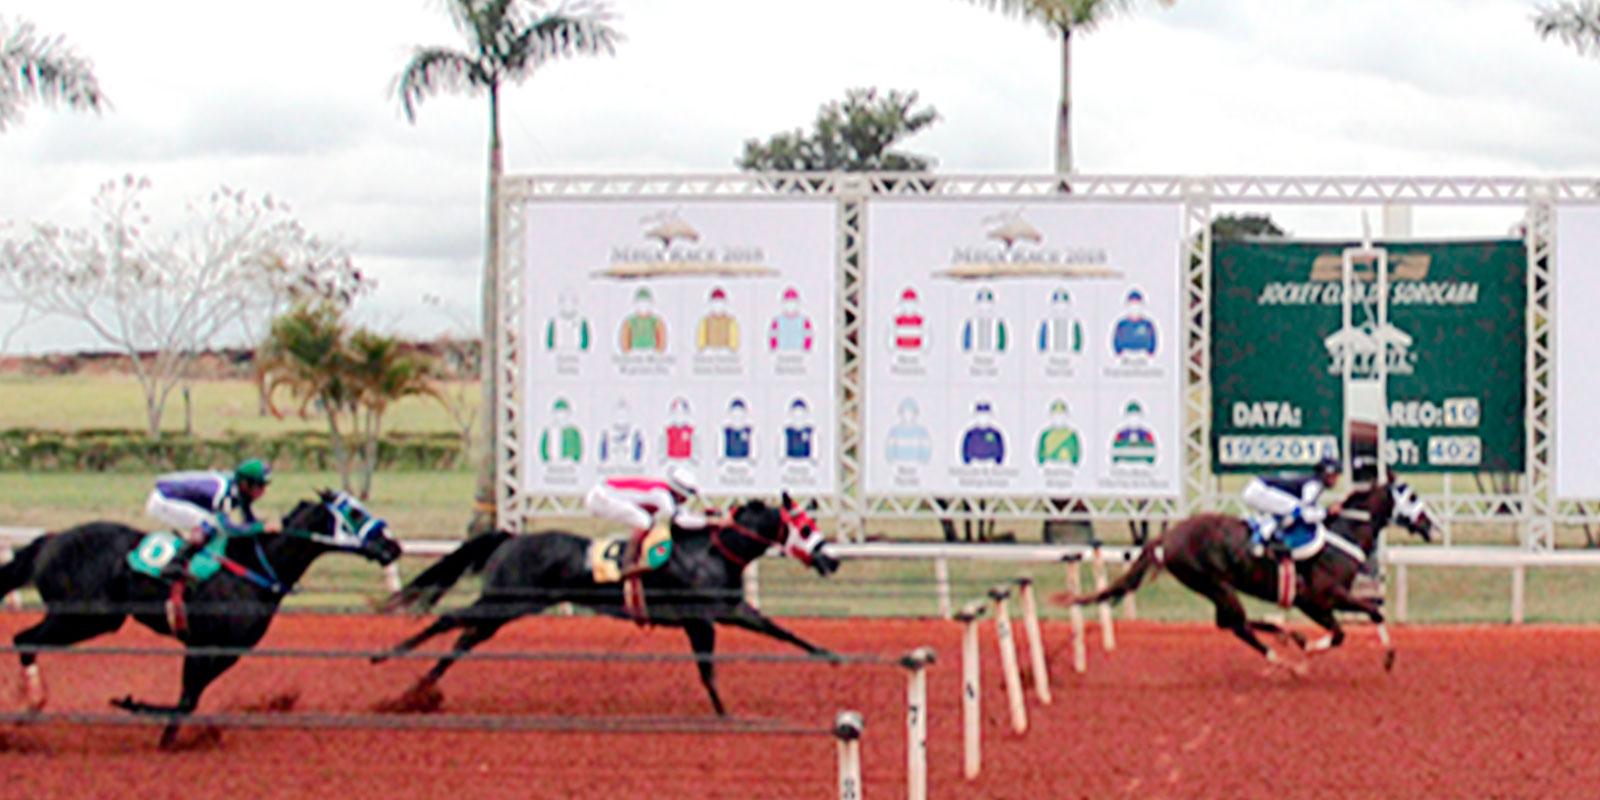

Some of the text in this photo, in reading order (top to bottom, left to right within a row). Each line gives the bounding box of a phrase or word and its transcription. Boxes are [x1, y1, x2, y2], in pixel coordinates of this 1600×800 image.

[1258, 282, 1323, 304] JOCKEY
[1392, 282, 1478, 304] SOROCABA
[1233, 402, 1302, 427] DATA:
[1449, 402, 1479, 423] 10
[1431, 439, 1477, 461] 402
[604, 539, 626, 571] 4
